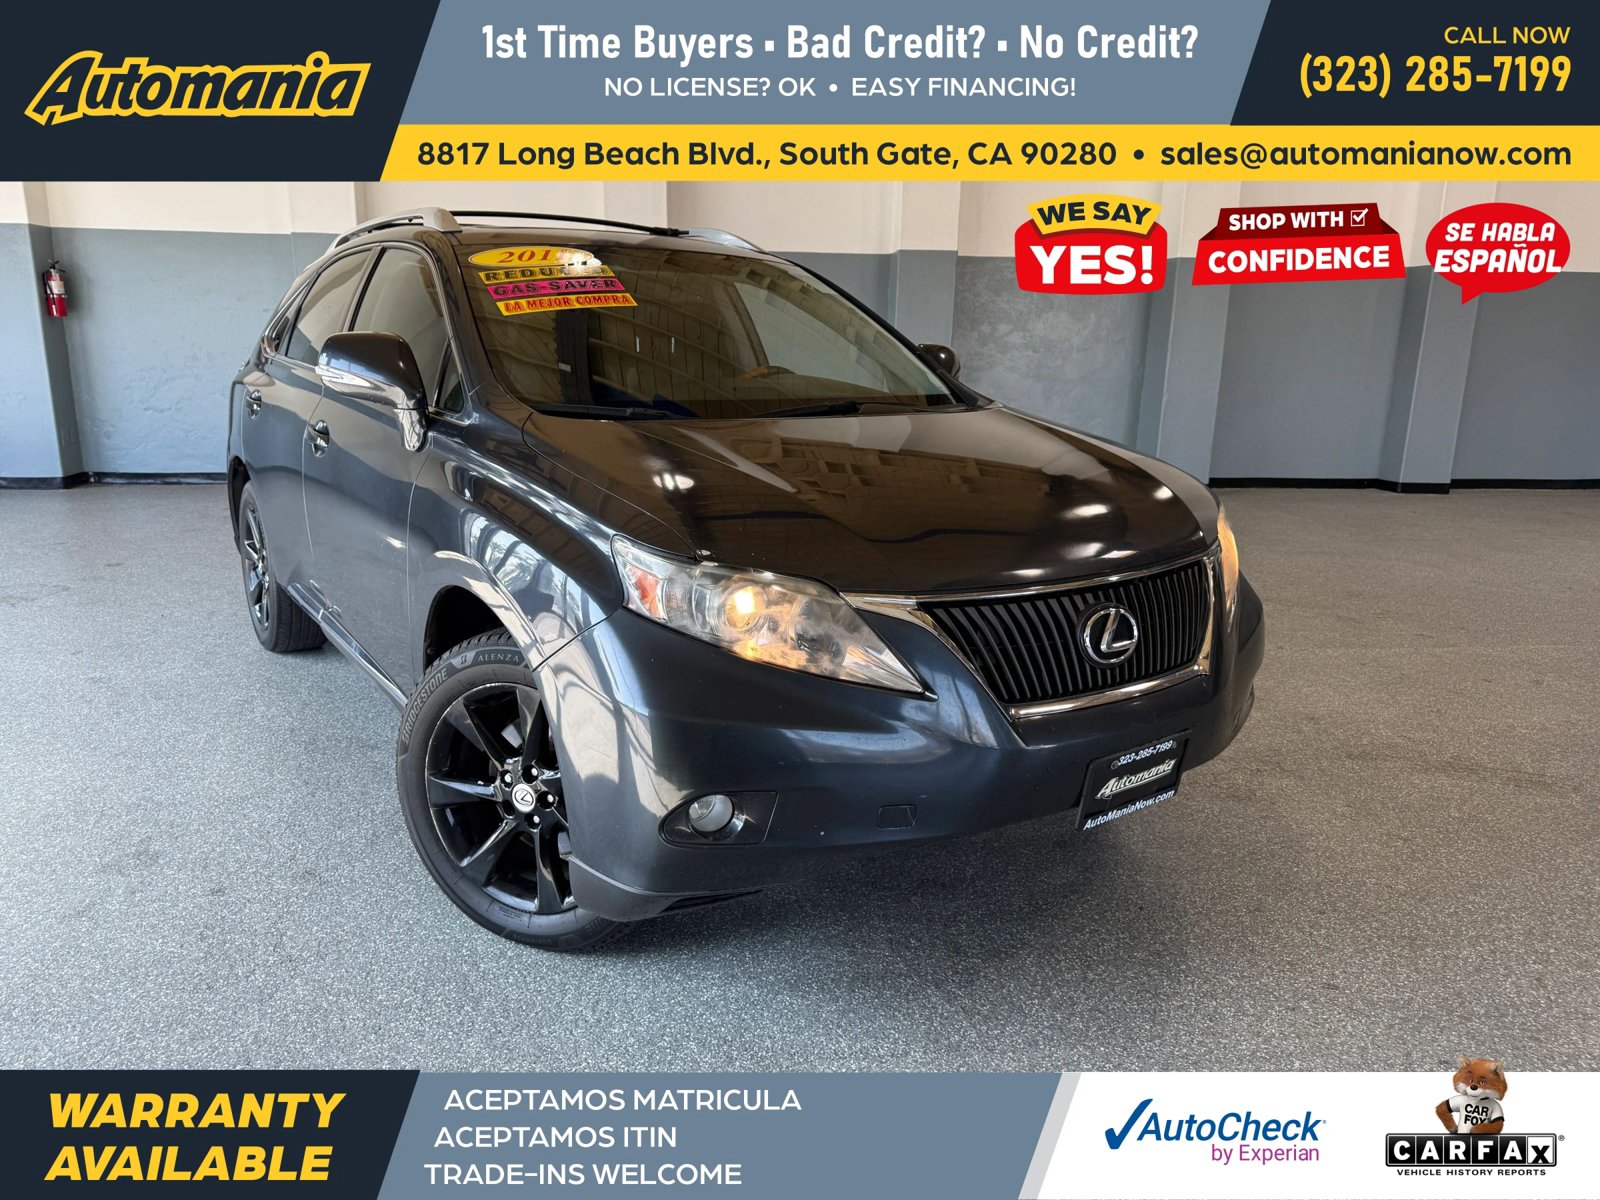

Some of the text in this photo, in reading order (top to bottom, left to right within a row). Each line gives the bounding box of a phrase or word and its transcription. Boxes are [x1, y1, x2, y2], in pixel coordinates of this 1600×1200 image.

[497, 249, 572, 264] 201
[504, 294, 632, 313] LA MEJOR COMPRA
[477, 653, 520, 663] ALENZA
[402, 668, 448, 746] BRIDGESTONE
[1095, 759, 1178, 799] Automania
